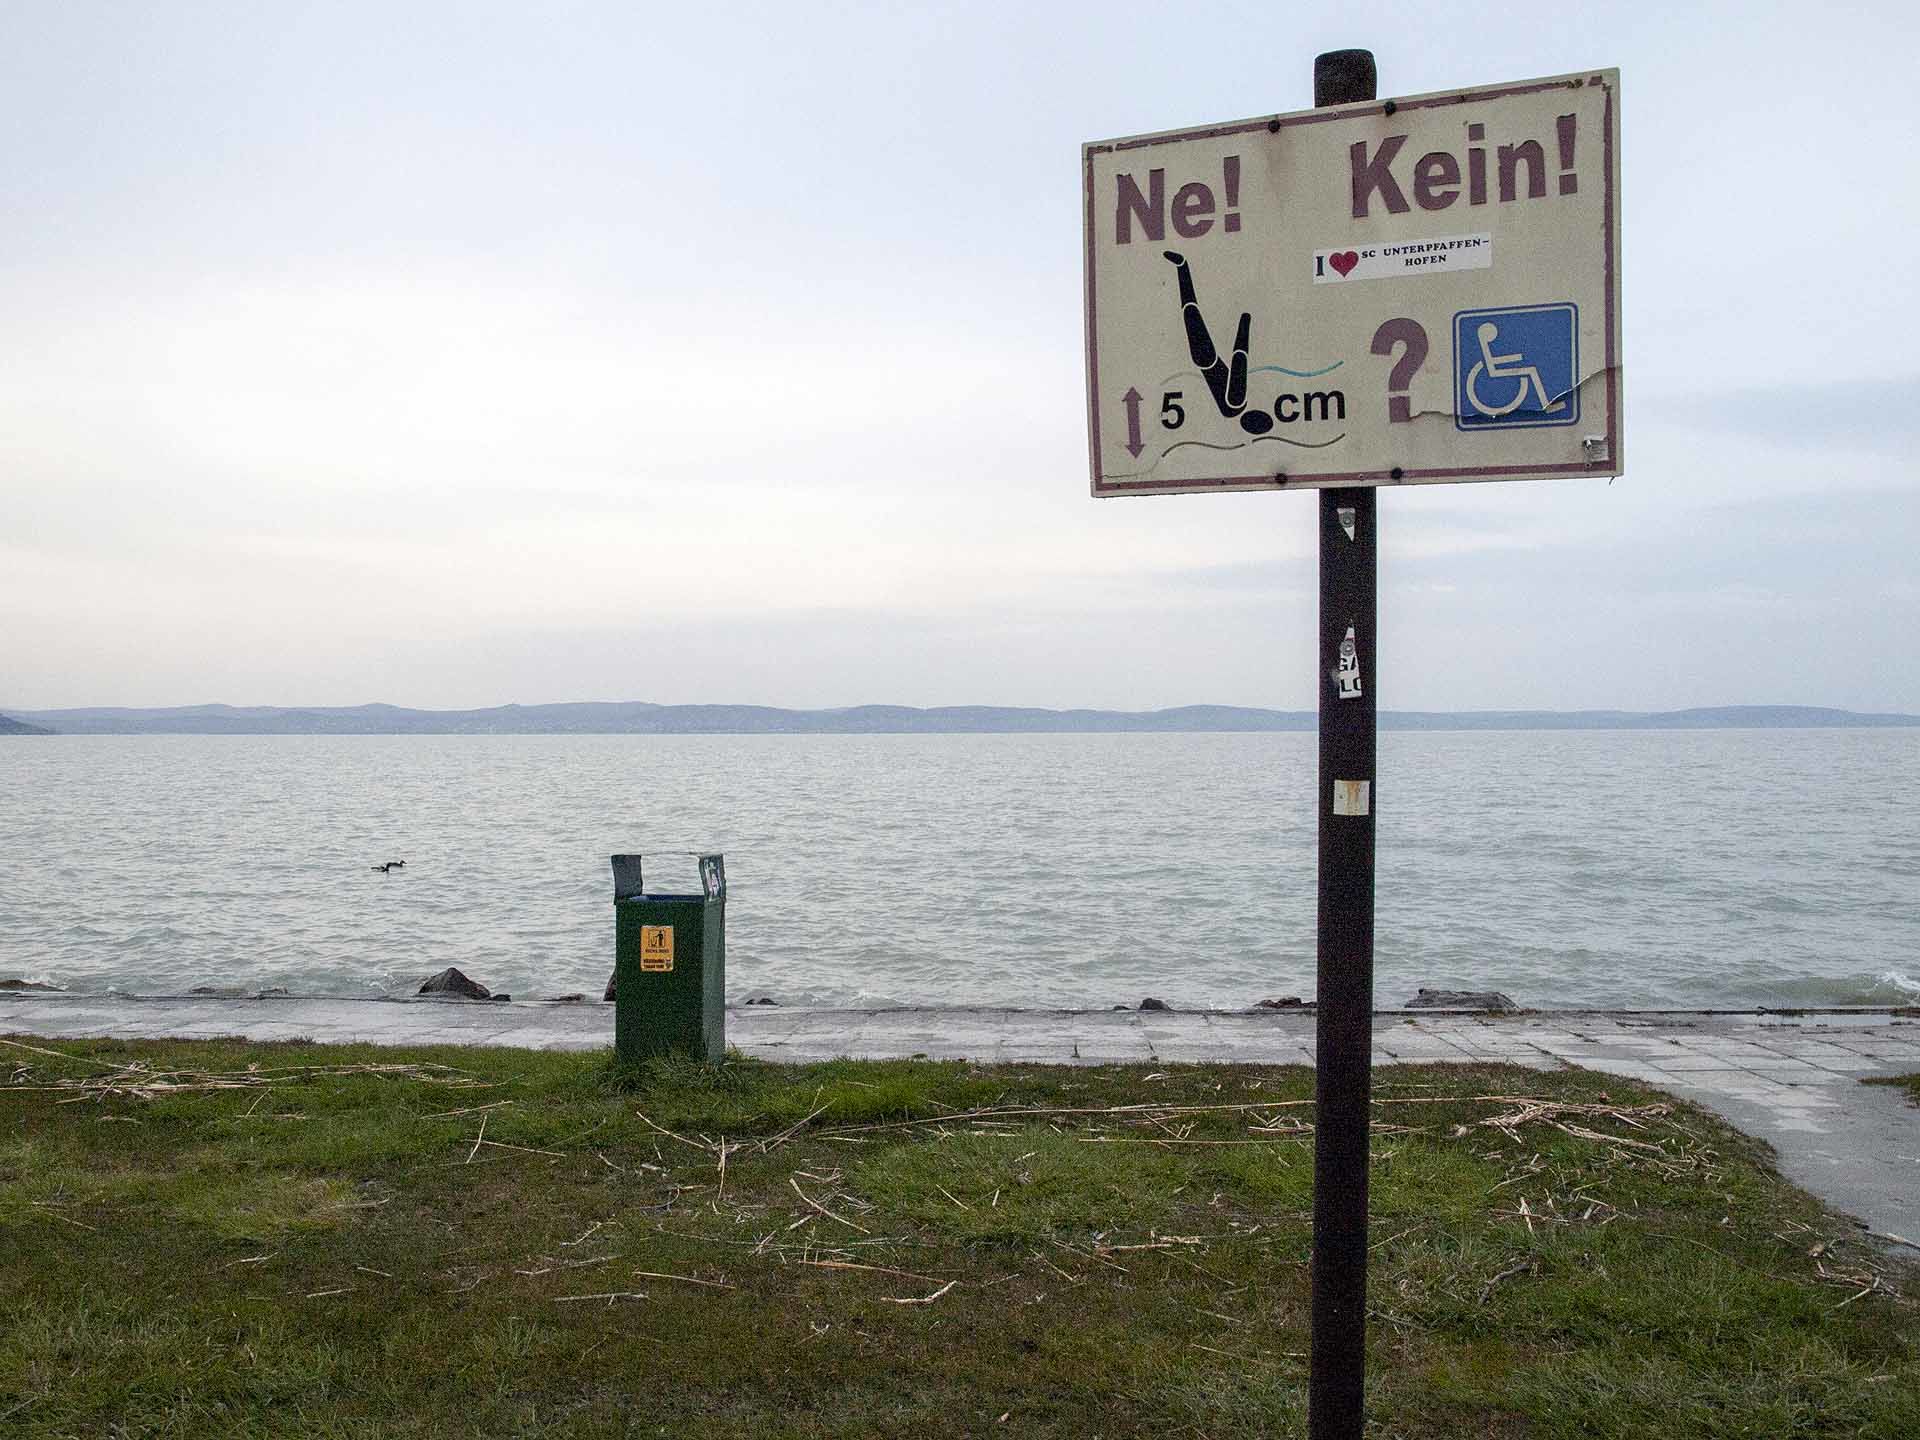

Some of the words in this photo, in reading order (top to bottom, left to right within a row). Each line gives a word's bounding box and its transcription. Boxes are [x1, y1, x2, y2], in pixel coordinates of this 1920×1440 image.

[1350, 112, 1578, 218] Kein!
[1115, 154, 1241, 245] Ne!
[1315, 255, 1325, 277] I
[1361, 249, 1376, 259] SC
[1383, 238, 1490, 256] UNTERPFAFFEN-
[1405, 254, 1448, 266] HOFEN
[1273, 390, 1346, 424] cm
